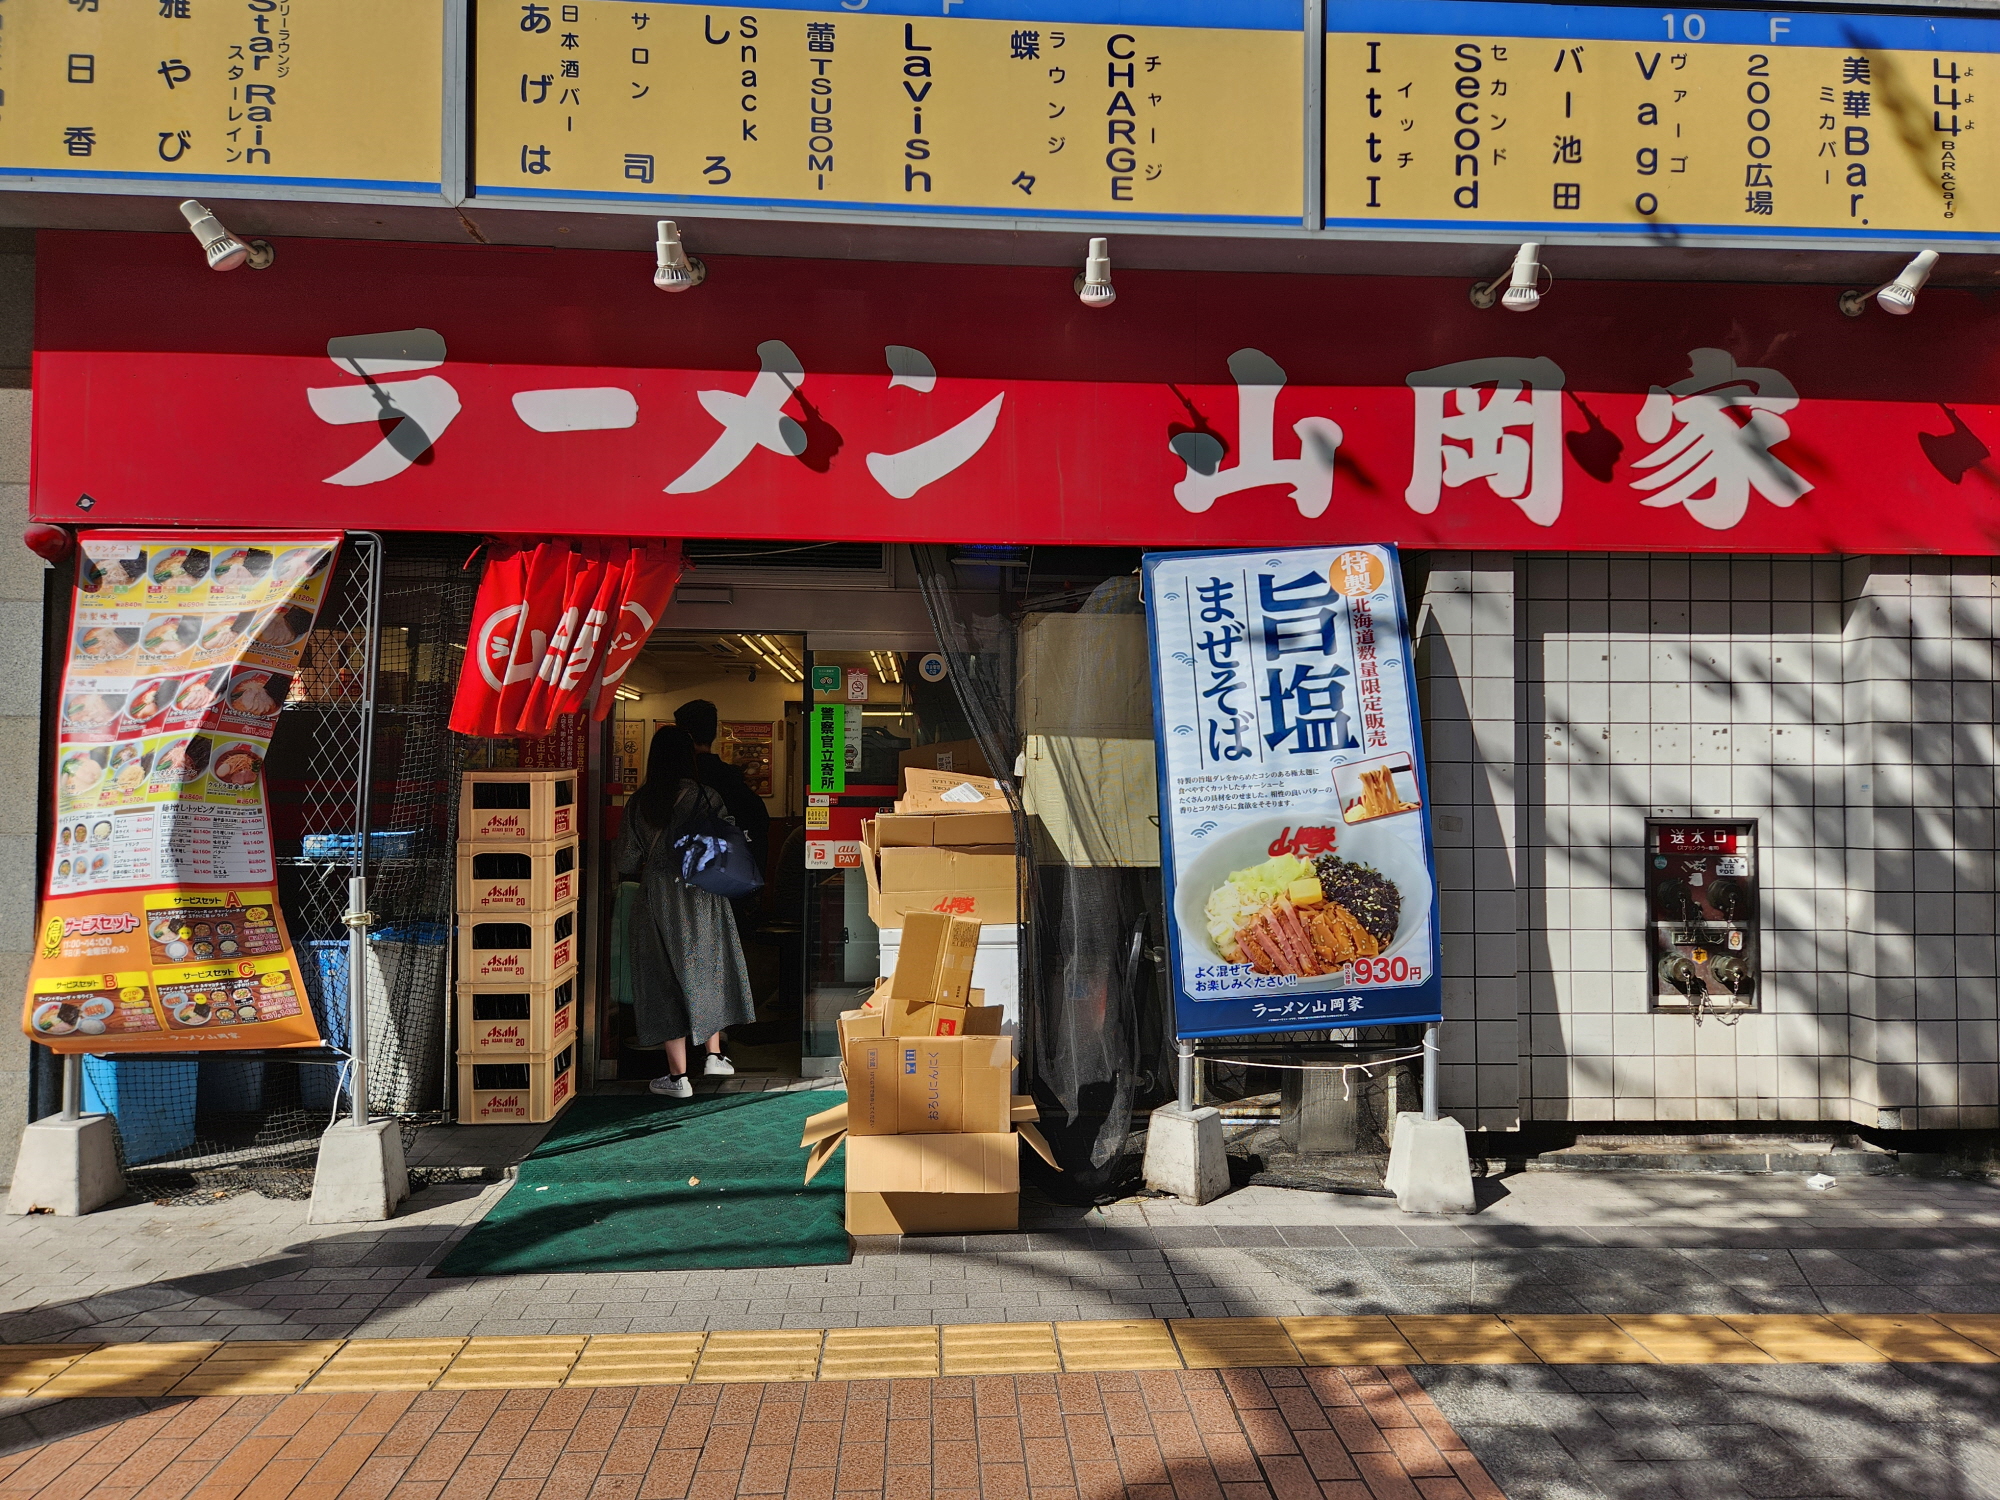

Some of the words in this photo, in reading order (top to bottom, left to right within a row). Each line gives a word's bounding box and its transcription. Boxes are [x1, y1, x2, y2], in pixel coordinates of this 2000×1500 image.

[247, 0, 278, 71] Star
[276, 0, 291, 79] リーラウンジ
[629, 12, 652, 100] サロン
[1662, 13, 1707, 41] 10
[1769, 17, 1793, 43] F
[226, 45, 245, 163] スターレイン
[519, 4, 554, 175] あげは
[560, 5, 581, 133] 日本酒バー
[702, 15, 732, 186] しろ
[738, 15, 759, 142] Snack
[904, 23, 933, 193] Lavish
[1047, 31, 1068, 155] ラウンジ
[1489, 44, 1509, 167] セカンド
[1933, 58, 1962, 137] 444
[245, 84, 277, 165] Rain
[1010, 30, 1041, 197] 蝶々
[1105, 33, 1137, 202] CHARGE
[1143, 54, 1164, 181] チャージ
[1396, 82, 1416, 169] イッチ
[1453, 43, 1483, 210] Second
[1551, 48, 1584, 210] バー池田
[1634, 51, 1662, 216] Vago
[1669, 53, 1689, 175] ヴァーゴ
[1743, 53, 1774, 216] 2000広場
[1818, 86, 1836, 185] ミカバー
[623, 152, 655, 184] 司
[1941, 141, 1956, 219] BAR&Cafe
[307, 327, 1004, 499] ラーメン
[1169, 346, 1816, 530] 山岡家
[1340, 553, 1373, 596] 特製
[1196, 576, 1255, 762] まぜそば
[1258, 570, 1360, 755] 旨塩
[1352, 598, 1388, 749] 北海道数量限定販売
[820, 707, 835, 790] 警察官立寄所
[1178, 780, 1285, 795] 食べやすくカットしたチャーシューと
[480, 827, 490, 836] 中
[515, 827, 525, 836] 20
[487, 815, 518, 826] Asahi
[1179, 799, 1295, 814] 香りとコクがさらに食欲をそそります。
[1670, 828, 1727, 844] 送水口
[838, 845, 857, 854] au
[838, 855, 857, 864] PAY
[65, 914, 138, 934] サービスセット
[174, 896, 222, 905] サービスセット
[224, 891, 242, 908] A
[480, 897, 490, 906] 中
[515, 897, 525, 906] 20
[487, 885, 518, 897] Asahi
[57, 980, 100, 989] サービスセット
[104, 974, 117, 990] B
[184, 968, 234, 979] サービスセット
[238, 961, 254, 978] C
[480, 967, 490, 975] 中
[515, 967, 525, 975] 20
[487, 955, 518, 966] Asahi
[1195, 963, 1254, 979] よく混ぜて
[1353, 956, 1422, 985] 930円
[480, 1038, 490, 1046] 中
[515, 1038, 525, 1046] 20
[487, 1026, 518, 1037] Asahi
[1252, 996, 1365, 1018] ラーメン山岡家
[480, 1108, 490, 1117] 中
[515, 1108, 525, 1117] 20
[487, 1096, 518, 1107] Asahi
[928, 1052, 940, 1121] おろしにんにく
